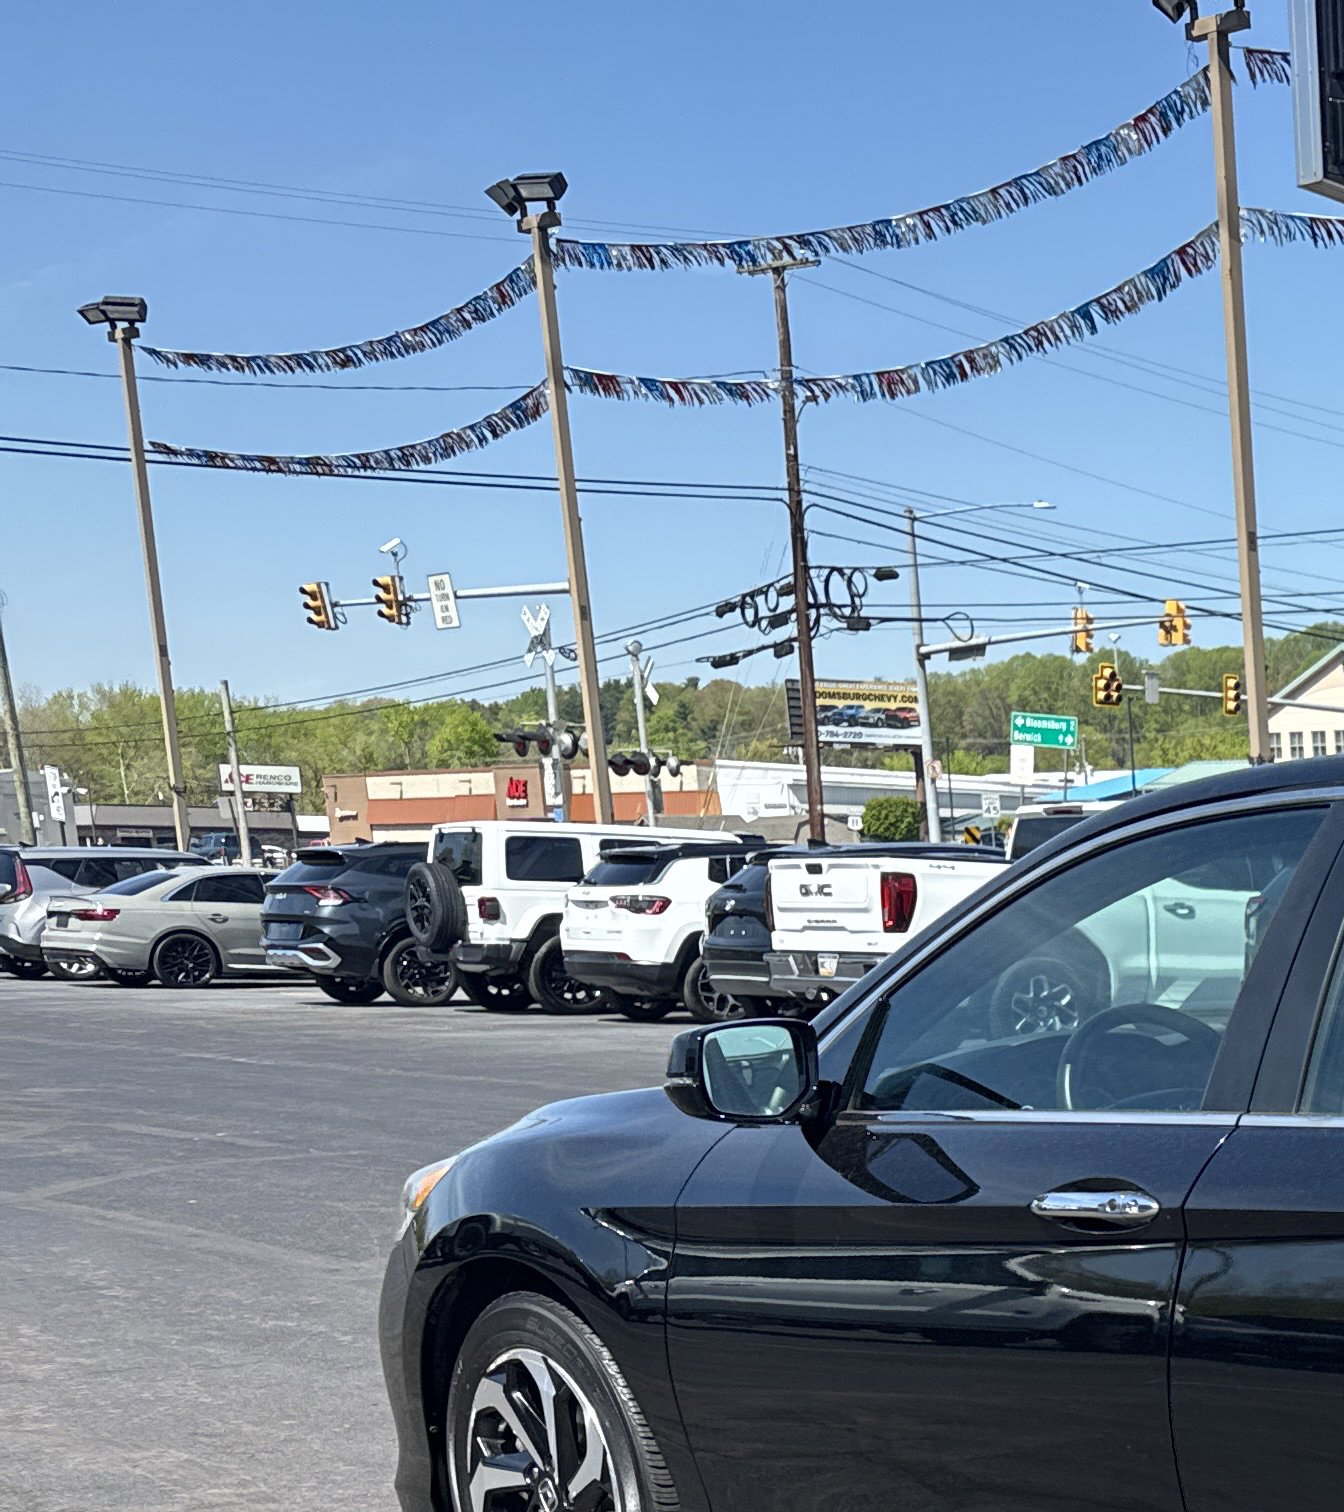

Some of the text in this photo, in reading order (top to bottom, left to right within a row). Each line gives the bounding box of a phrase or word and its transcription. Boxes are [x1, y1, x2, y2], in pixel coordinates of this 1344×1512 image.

[434, 579, 446, 591] NO
[1025, 717, 1075, 732] Bloomsburg 2
[255, 773, 292, 782] RENCO
[984, 806, 1000, 815] 45
